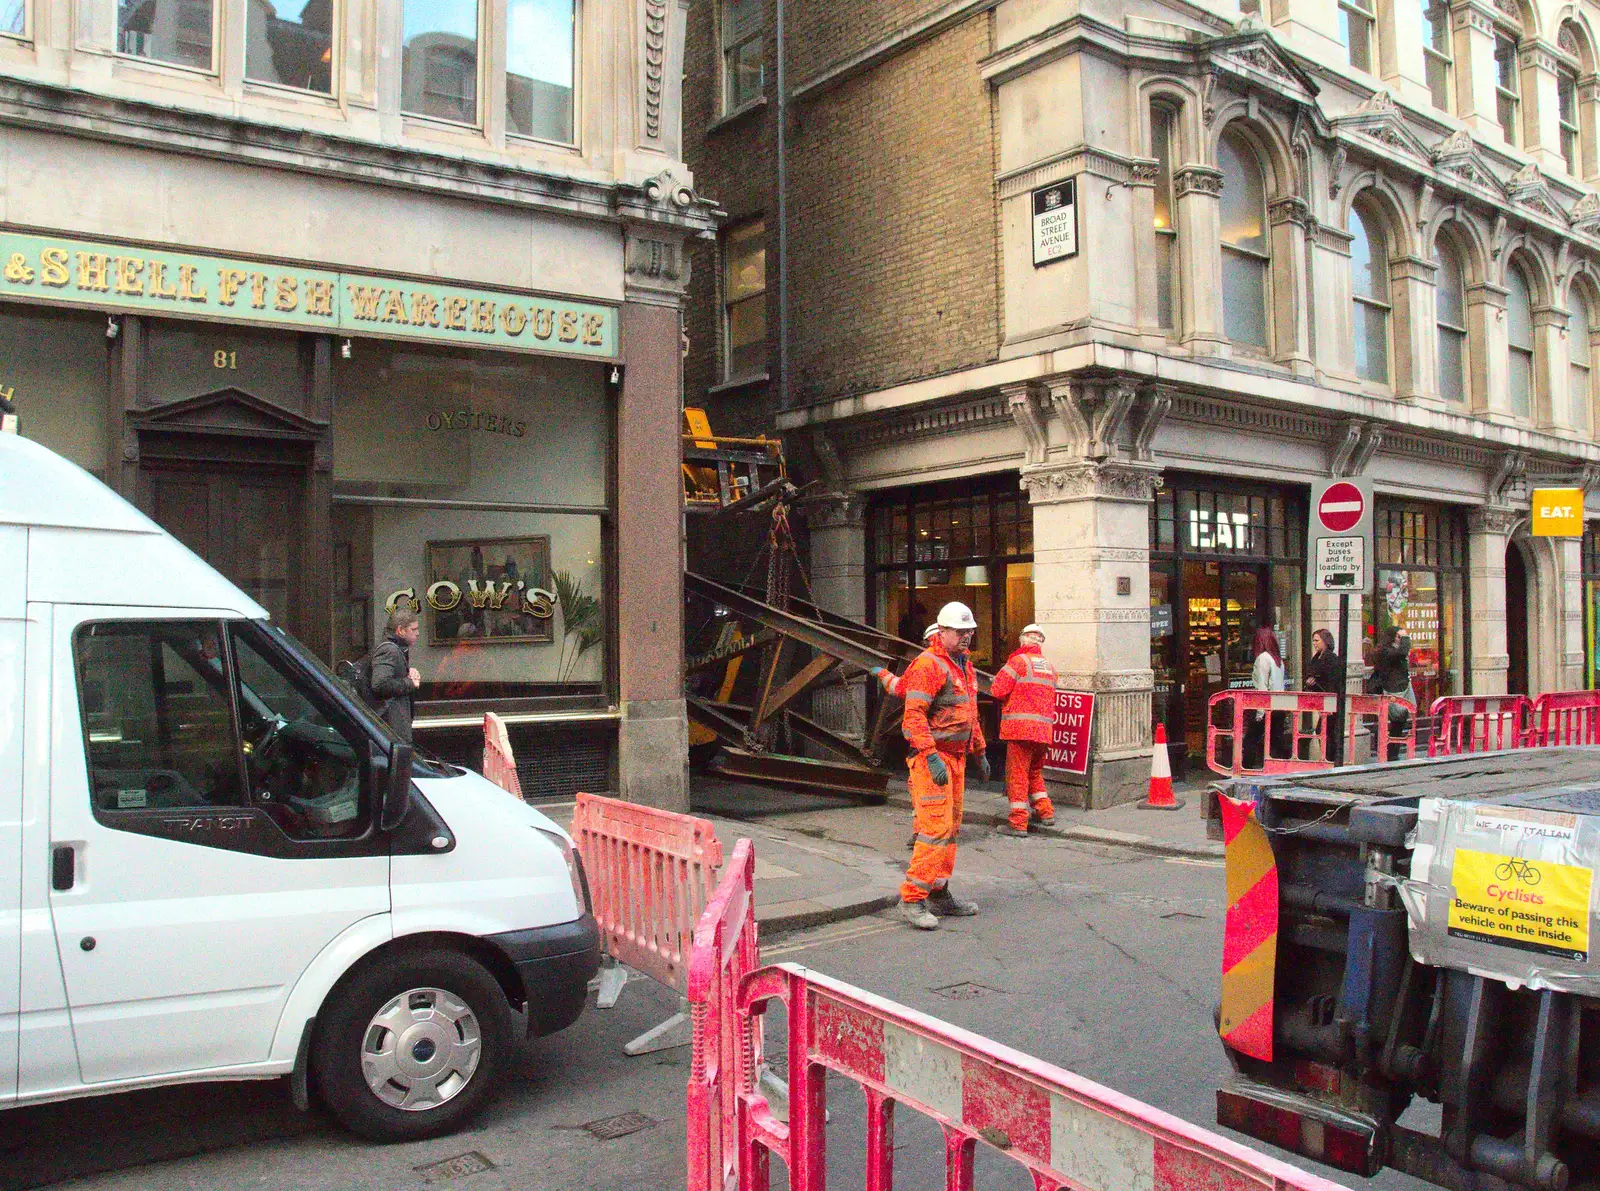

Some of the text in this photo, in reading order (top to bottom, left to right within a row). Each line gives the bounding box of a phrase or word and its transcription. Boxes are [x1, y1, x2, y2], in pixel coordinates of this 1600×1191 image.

[1041, 212, 1067, 227] BROAD
[1041, 222, 1067, 237] STREET
[1040, 232, 1070, 247] AVENUE
[1048, 245, 1062, 255] EC2
[4, 247, 604, 346] & SHELL FISH WAREHOUSE
[213, 350, 237, 369] 81
[427, 411, 526, 438] OYSTERS
[1540, 506, 1575, 518] EAT.
[1326, 540, 1353, 548] Except
[1054, 693, 1082, 709] ISTS
[1053, 712, 1085, 727] OUNT
[1053, 730, 1078, 745] USE
[1524, 826, 1571, 840] ITALIAN
[1487, 884, 1544, 905] Cyclists
[1455, 898, 1579, 929] Beware of passing this
[1459, 915, 1573, 942] vehicle on the inside
